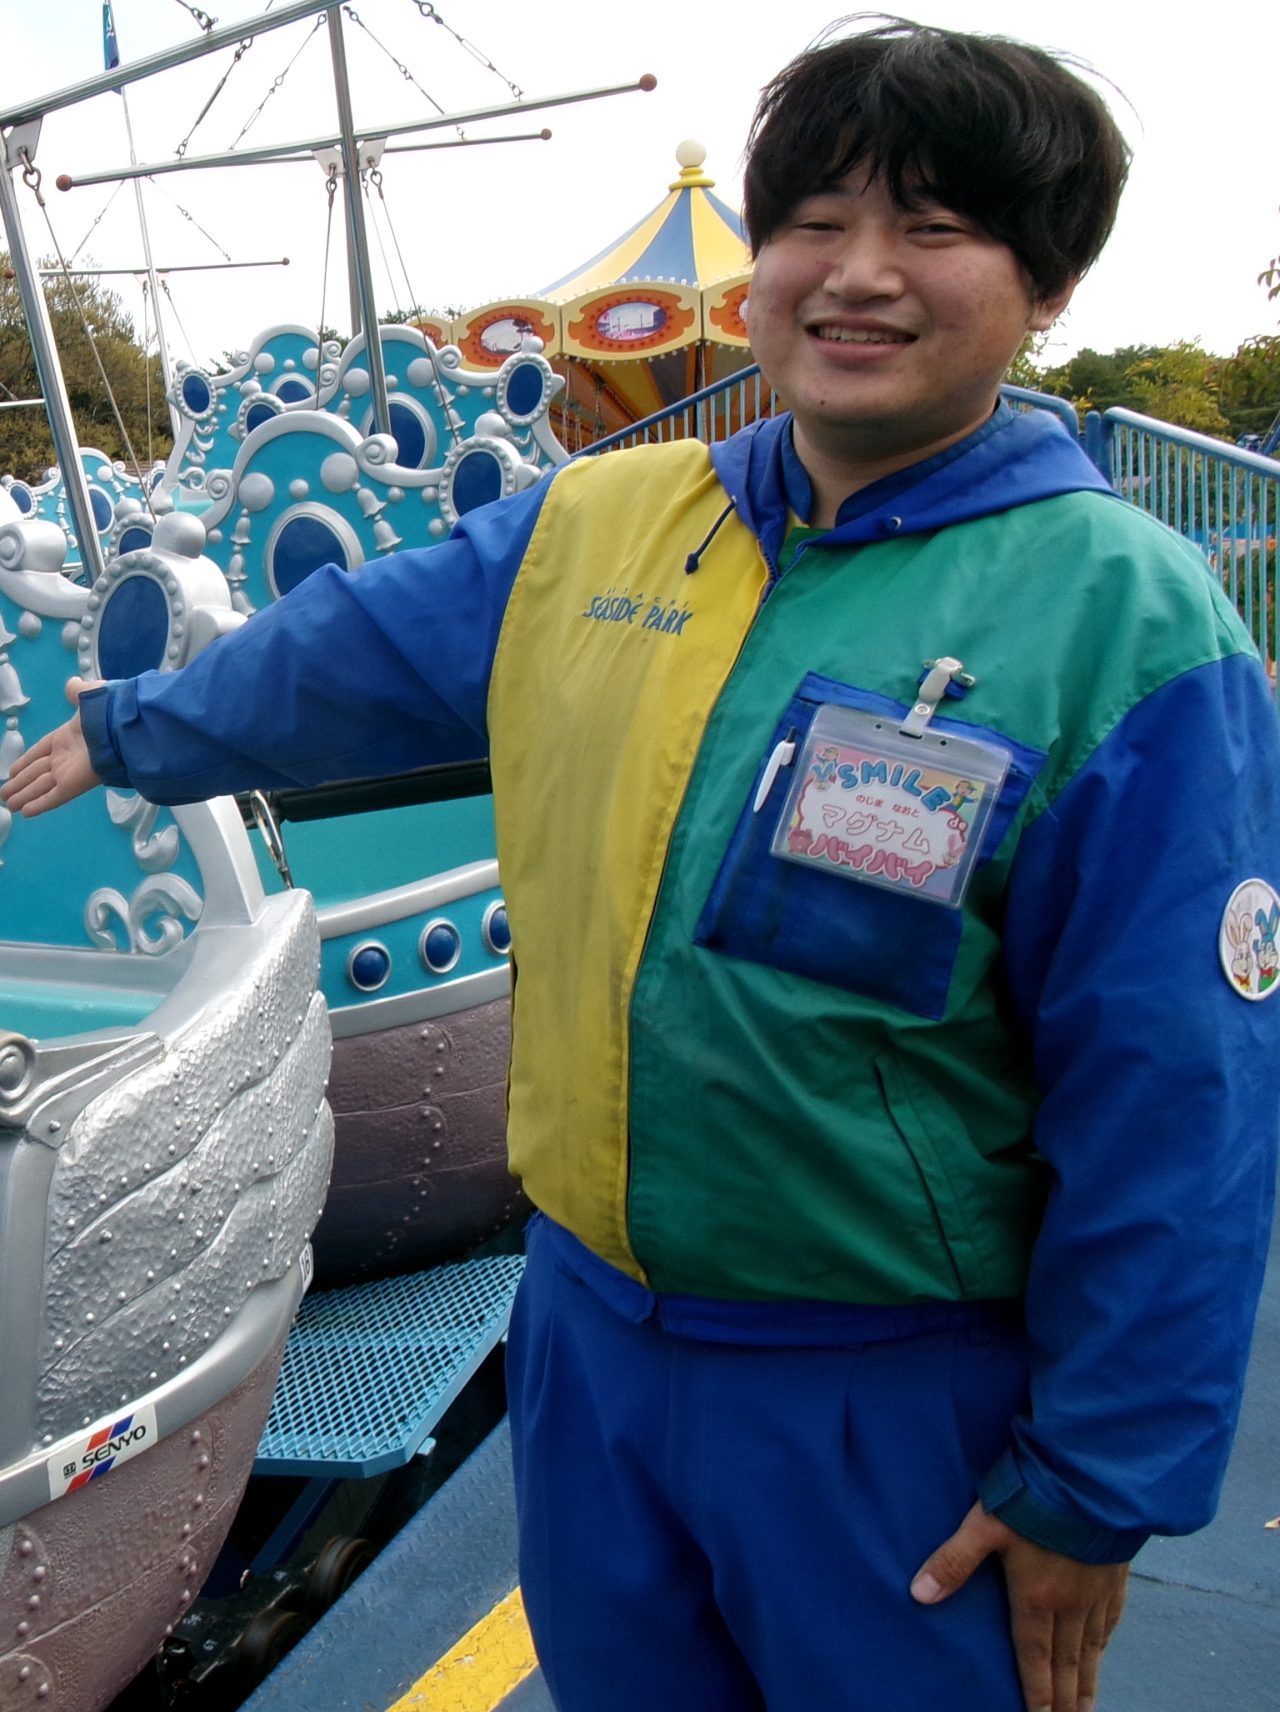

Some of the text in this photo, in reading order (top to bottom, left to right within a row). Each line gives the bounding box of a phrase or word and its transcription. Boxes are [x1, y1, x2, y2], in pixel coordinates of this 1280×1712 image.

[582, 595, 694, 636] SEASIDE PARK
[837, 759, 952, 812] SMILE
[821, 803, 931, 855] マグナム
[809, 833, 934, 887] バイバイ
[81, 1423, 147, 1470] SENYO
